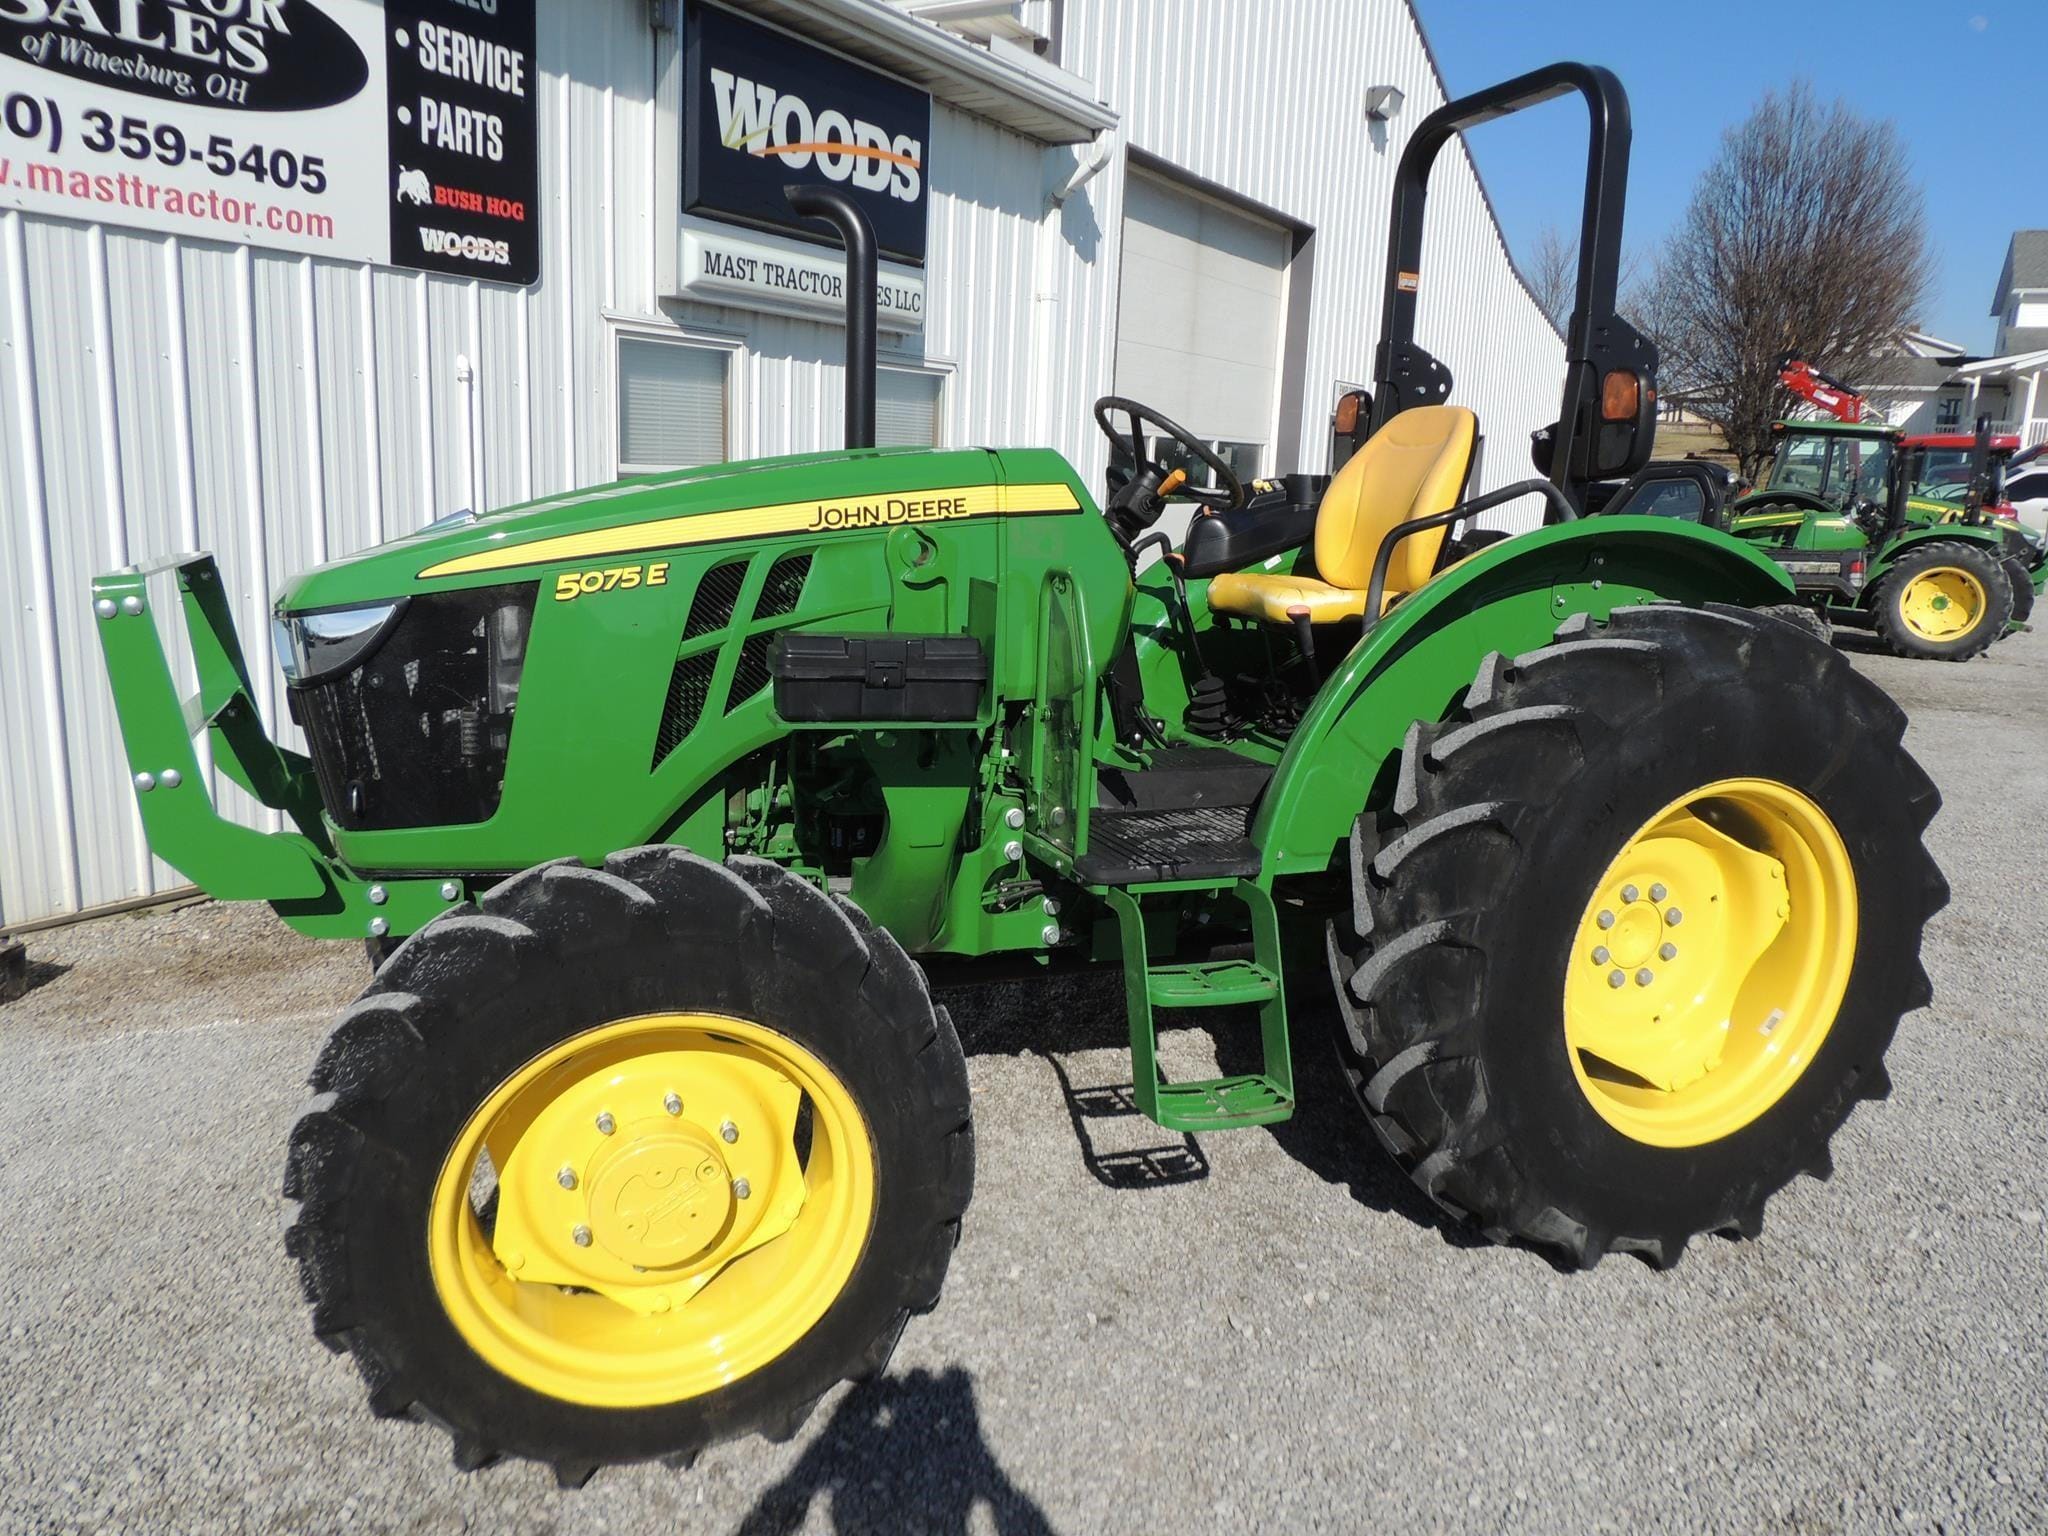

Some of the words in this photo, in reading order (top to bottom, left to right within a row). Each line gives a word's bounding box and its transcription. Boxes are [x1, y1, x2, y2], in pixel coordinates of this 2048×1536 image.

[21, 32, 55, 64] of
[205, 73, 249, 105] OH
[418, 20, 525, 97] SERVICE
[81, 108, 327, 194] 359-5405
[420, 96, 503, 161] PARTS
[710, 67, 921, 202] WOODS
[434, 184, 484, 213] BUSH
[486, 196, 525, 221] HOG
[419, 226, 509, 265] WOODS
[704, 250, 758, 282] MAST
[763, 262, 843, 298] TRACTOR
[895, 288, 921, 313] LLC
[808, 505, 880, 528] JOHN
[887, 497, 967, 521] DEERE
[555, 566, 643, 601] 5075
[646, 562, 671, 586] E
